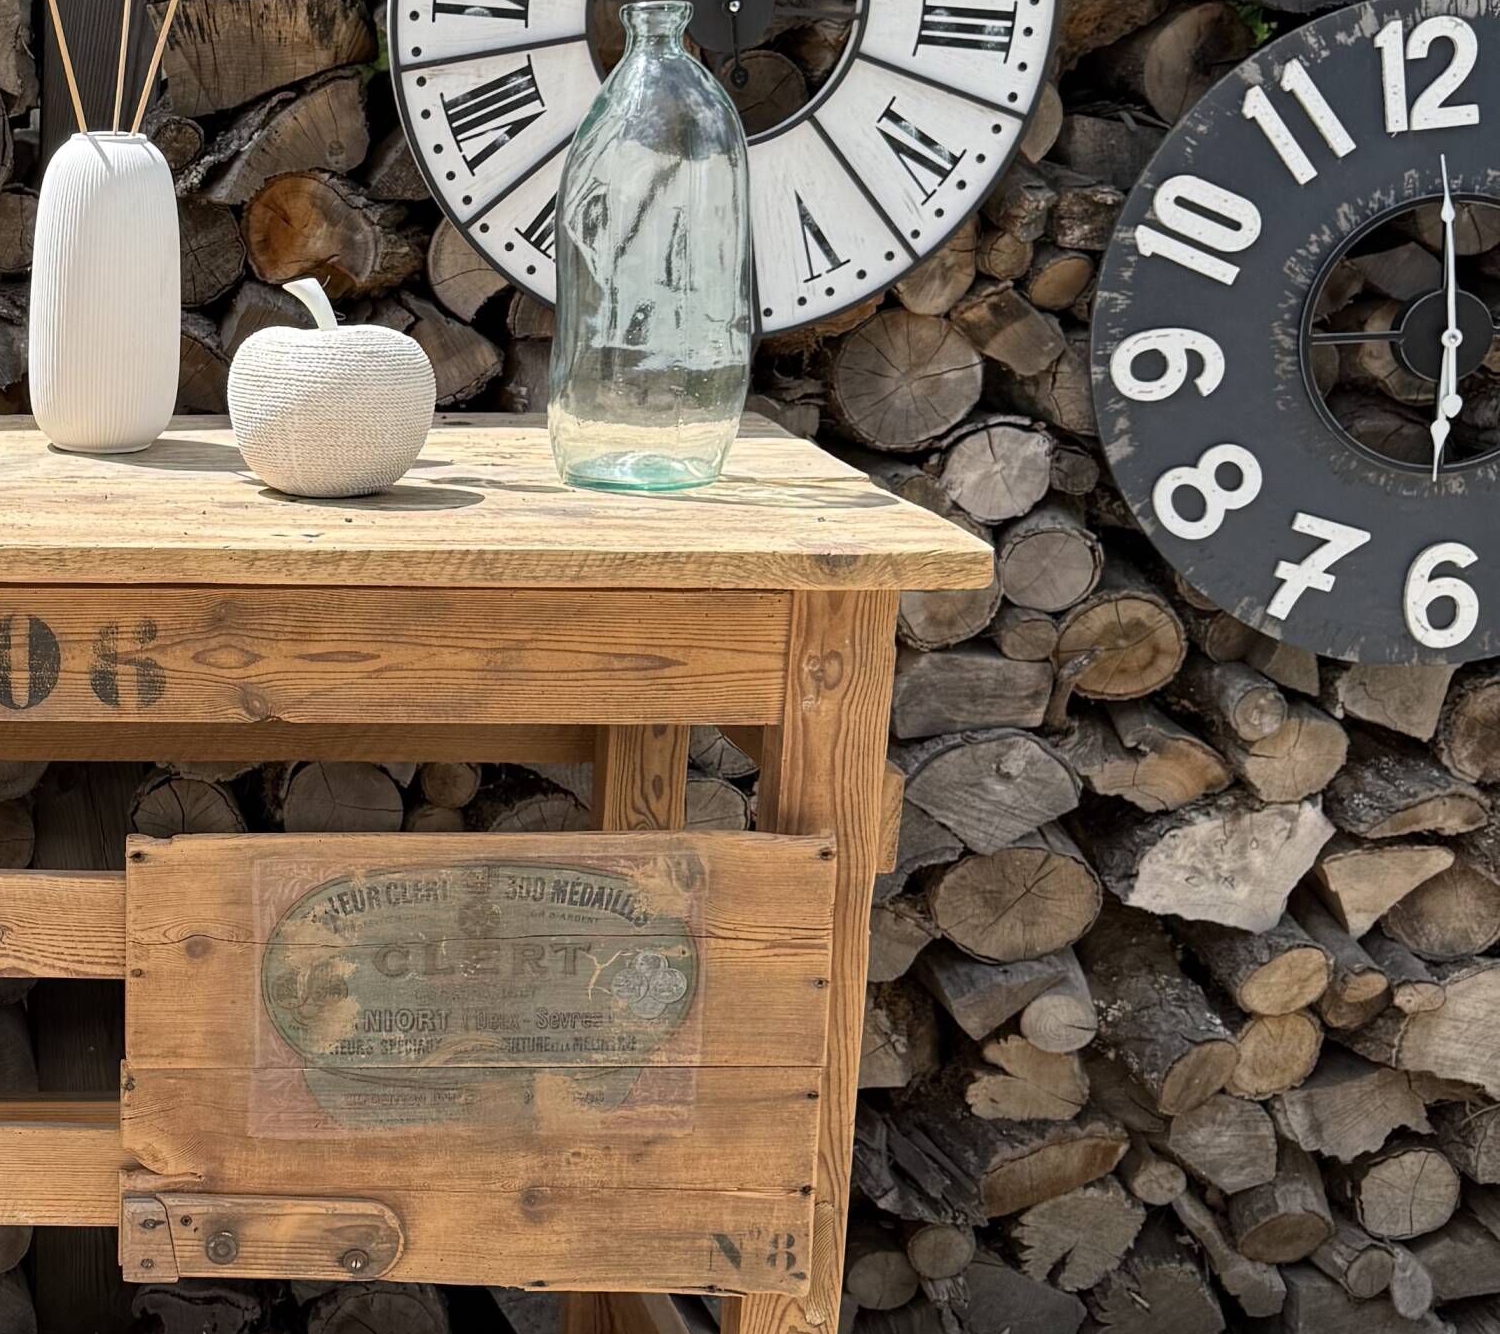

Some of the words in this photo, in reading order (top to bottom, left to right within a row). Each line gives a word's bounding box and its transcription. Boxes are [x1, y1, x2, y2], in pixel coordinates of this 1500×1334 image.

[440, 54, 548, 177] VIII
[1241, 58, 1357, 186] 11
[1373, 15, 1480, 135] 12
[875, 96, 968, 205] IV
[794, 190, 851, 283] V
[1134, 174, 1262, 286] 10
[1109, 327, 1225, 402] 9
[1152, 443, 1263, 541] 8
[1265, 511, 1372, 621] 7
[1403, 541, 1480, 649] 6
[371, 940, 591, 978] CLERT
[362, 1008, 450, 1034] NIORT
